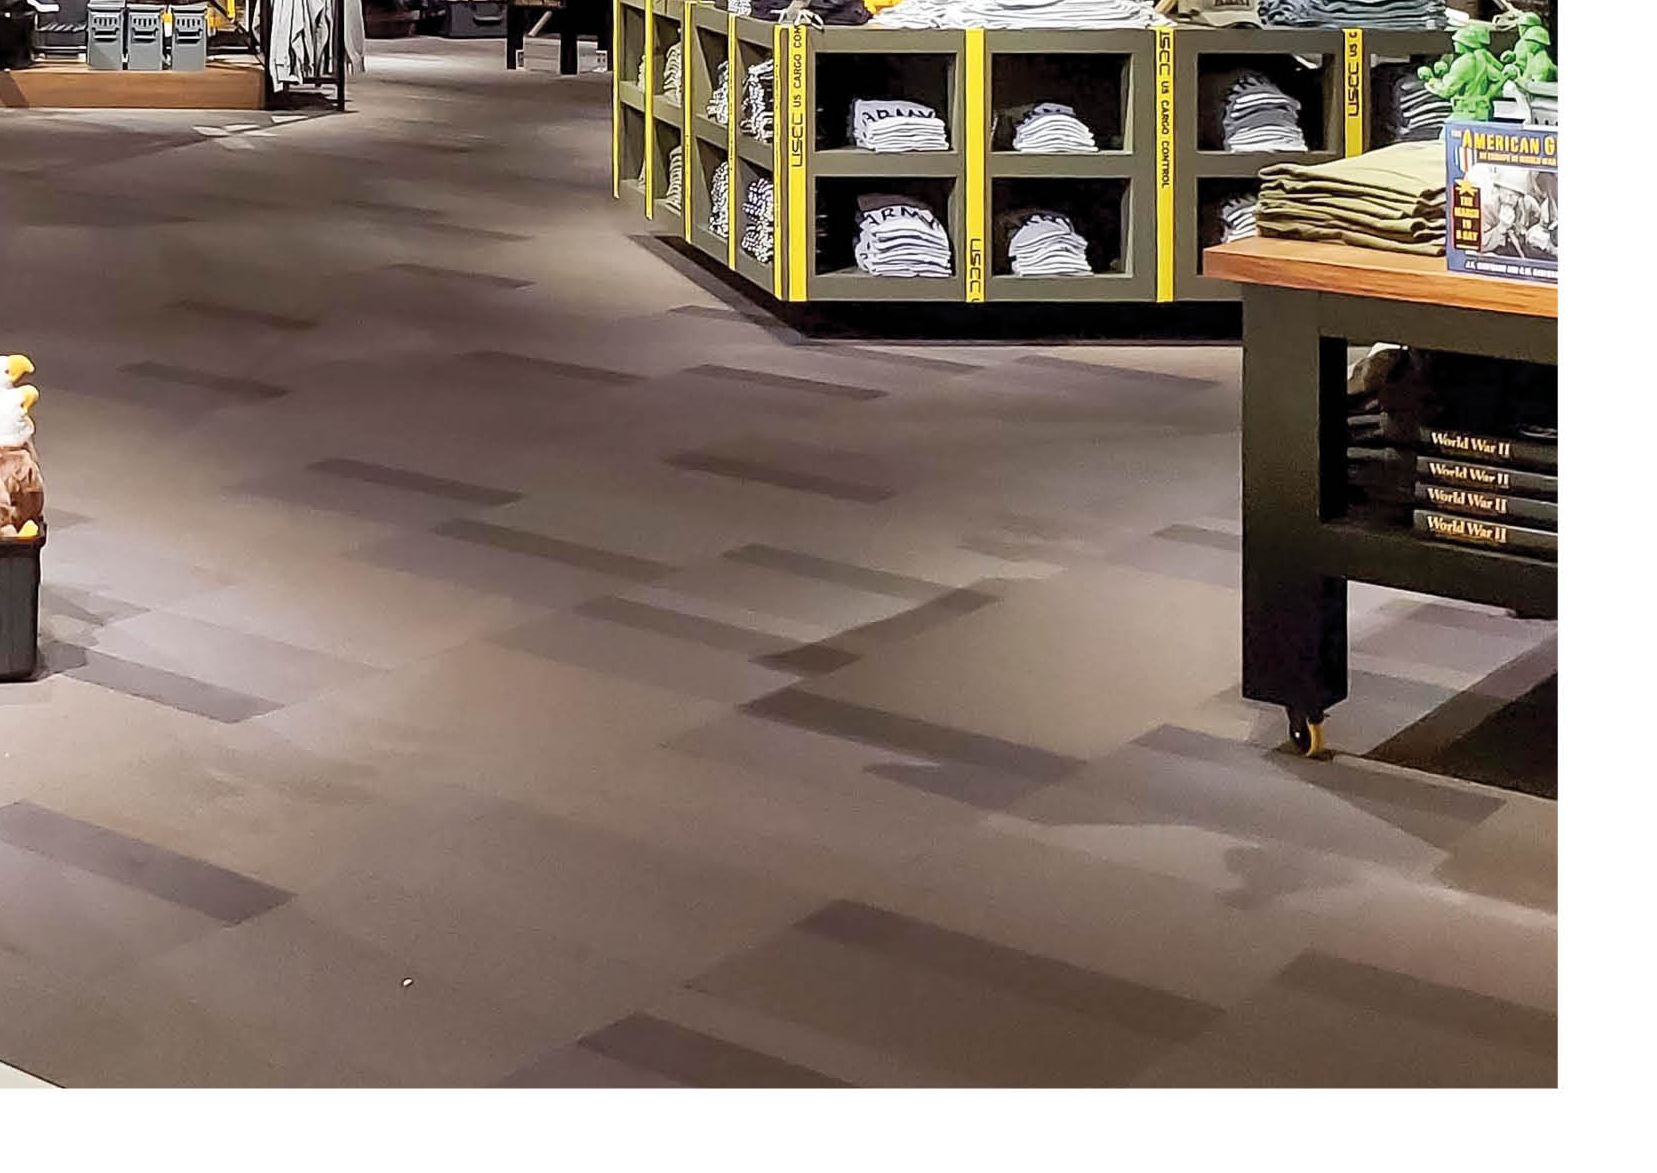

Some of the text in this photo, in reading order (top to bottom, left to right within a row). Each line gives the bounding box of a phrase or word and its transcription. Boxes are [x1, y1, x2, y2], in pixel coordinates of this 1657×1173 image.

[793, 54, 801, 89] CARGO
[793, 93, 801, 107] US
[1160, 81, 1169, 94] US
[1161, 99, 1169, 135] CARGO
[1462, 129, 1540, 155] AMERICAN
[1161, 141, 1170, 188] CONTROL
[1432, 432, 1511, 458] World War II
[1429, 463, 1510, 489] World War II
[1427, 487, 1508, 514] World War II
[1427, 515, 1507, 543] World War II
